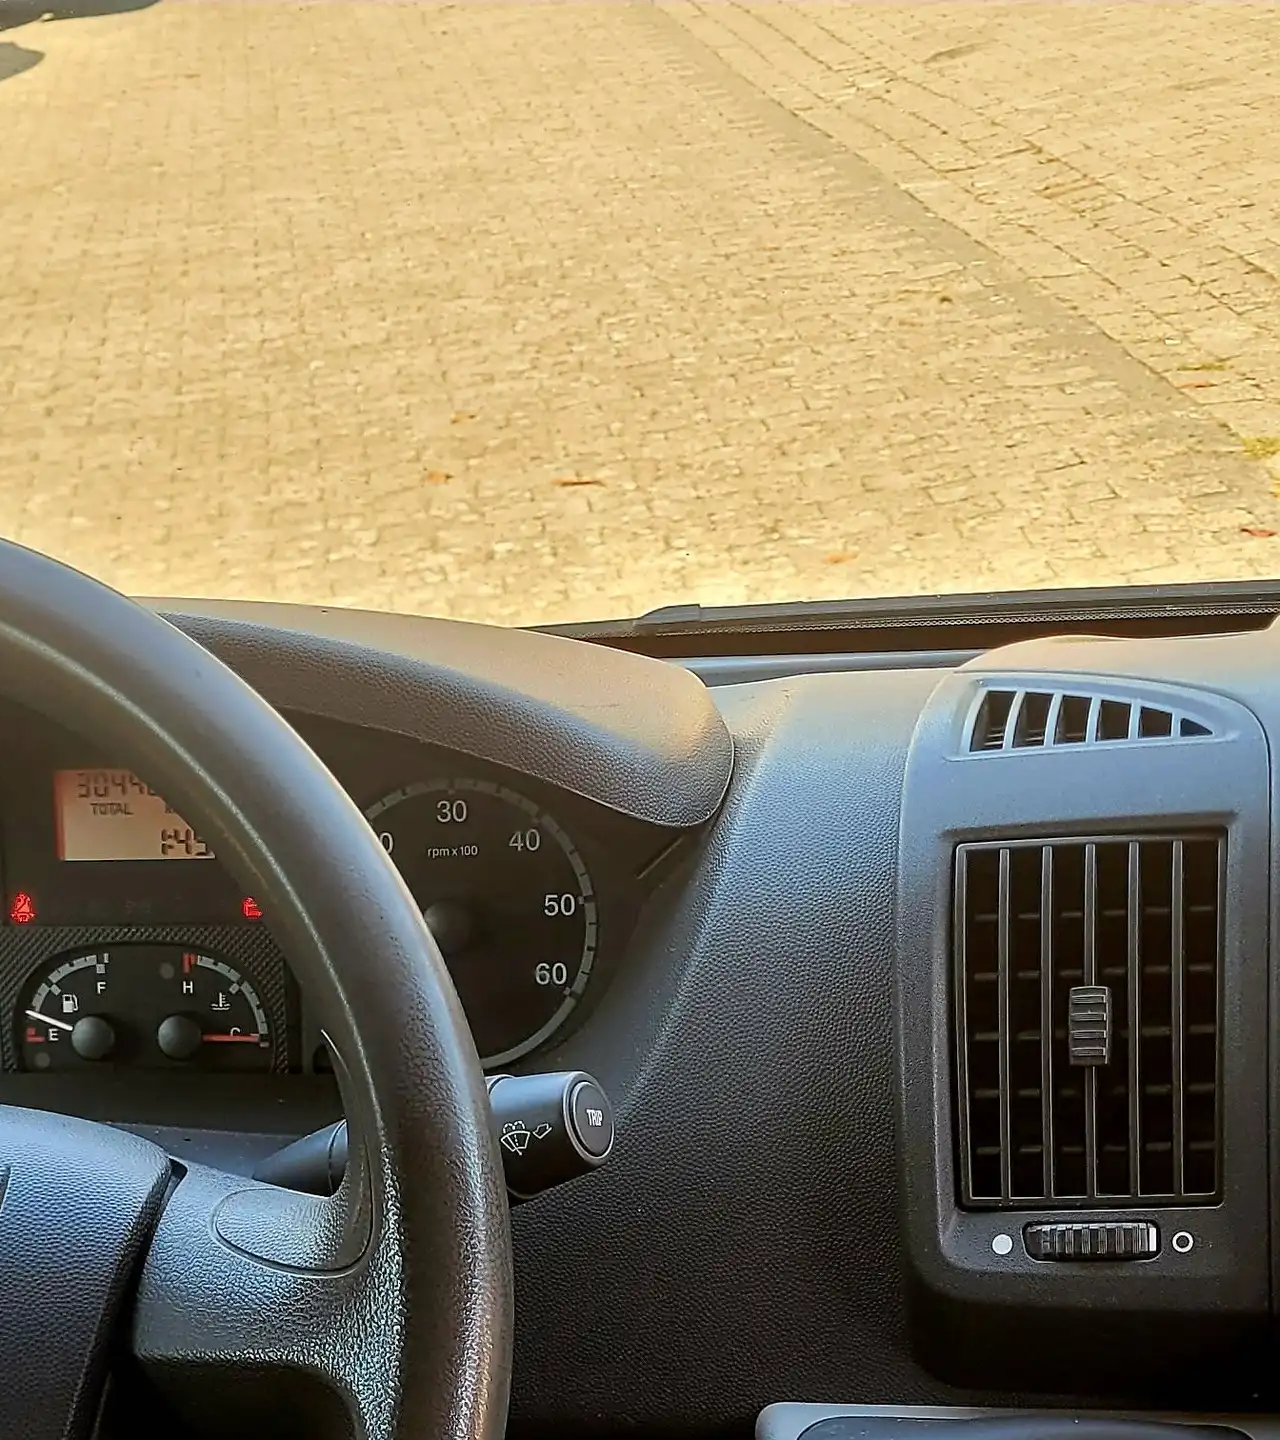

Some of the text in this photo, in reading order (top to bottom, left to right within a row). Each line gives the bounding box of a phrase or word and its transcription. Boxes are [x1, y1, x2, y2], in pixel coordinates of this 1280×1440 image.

[77, 772, 157, 798] 3044
[90, 802, 134, 816] TOTAL
[436, 800, 468, 823] 30
[378, 832, 394, 855] 0
[509, 828, 541, 852] 40
[427, 847, 450, 858] rpm
[460, 845, 478, 857] 100
[544, 894, 576, 917] 50
[535, 962, 568, 986] 60
[97, 981, 107, 994] F
[182, 980, 194, 994] H
[48, 1028, 60, 1042] E
[586, 1108, 603, 1126] TRIP
